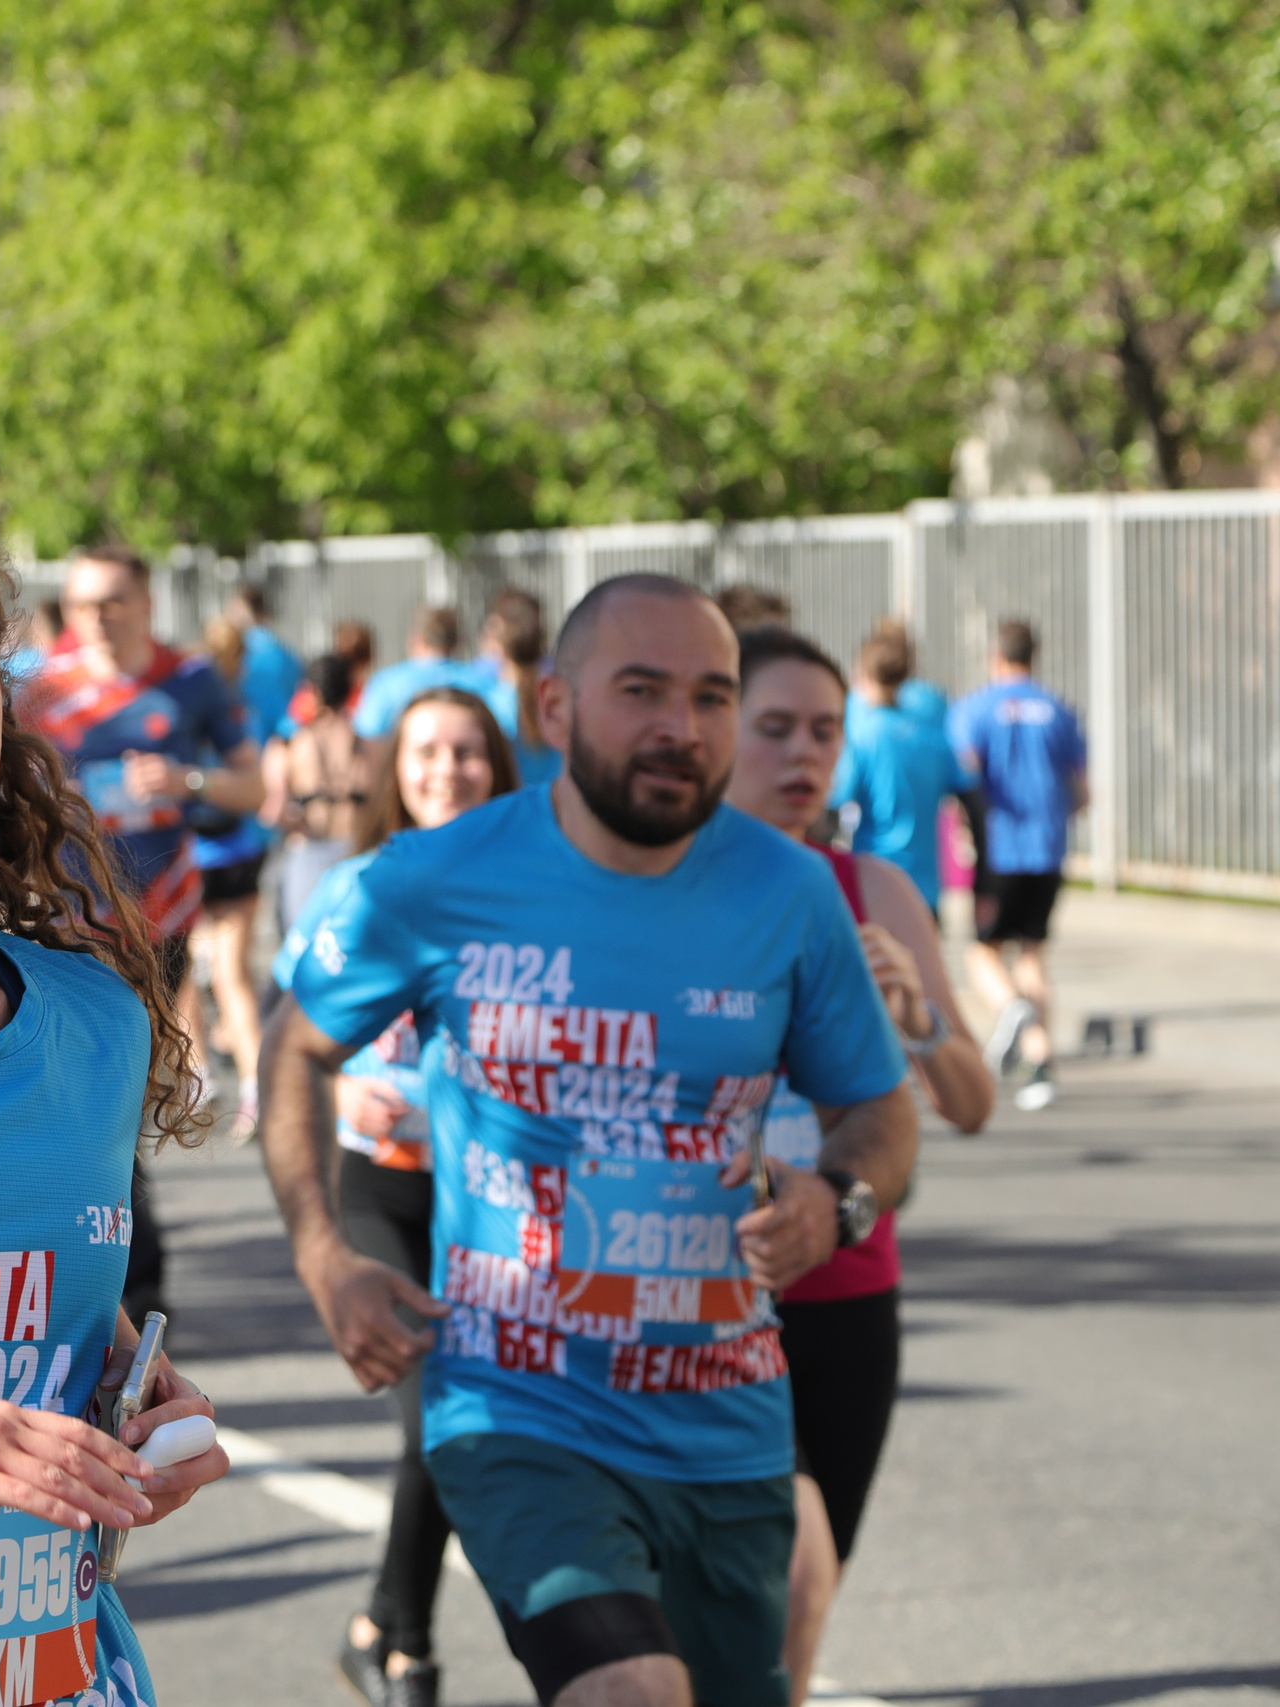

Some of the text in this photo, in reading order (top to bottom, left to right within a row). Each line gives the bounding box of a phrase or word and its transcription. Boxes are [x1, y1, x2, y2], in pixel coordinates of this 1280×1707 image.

[455, 942, 573, 1004] 2024
[469, 1002, 657, 1068] #МЕЧТА
[605, 1211, 730, 1272] 26120
